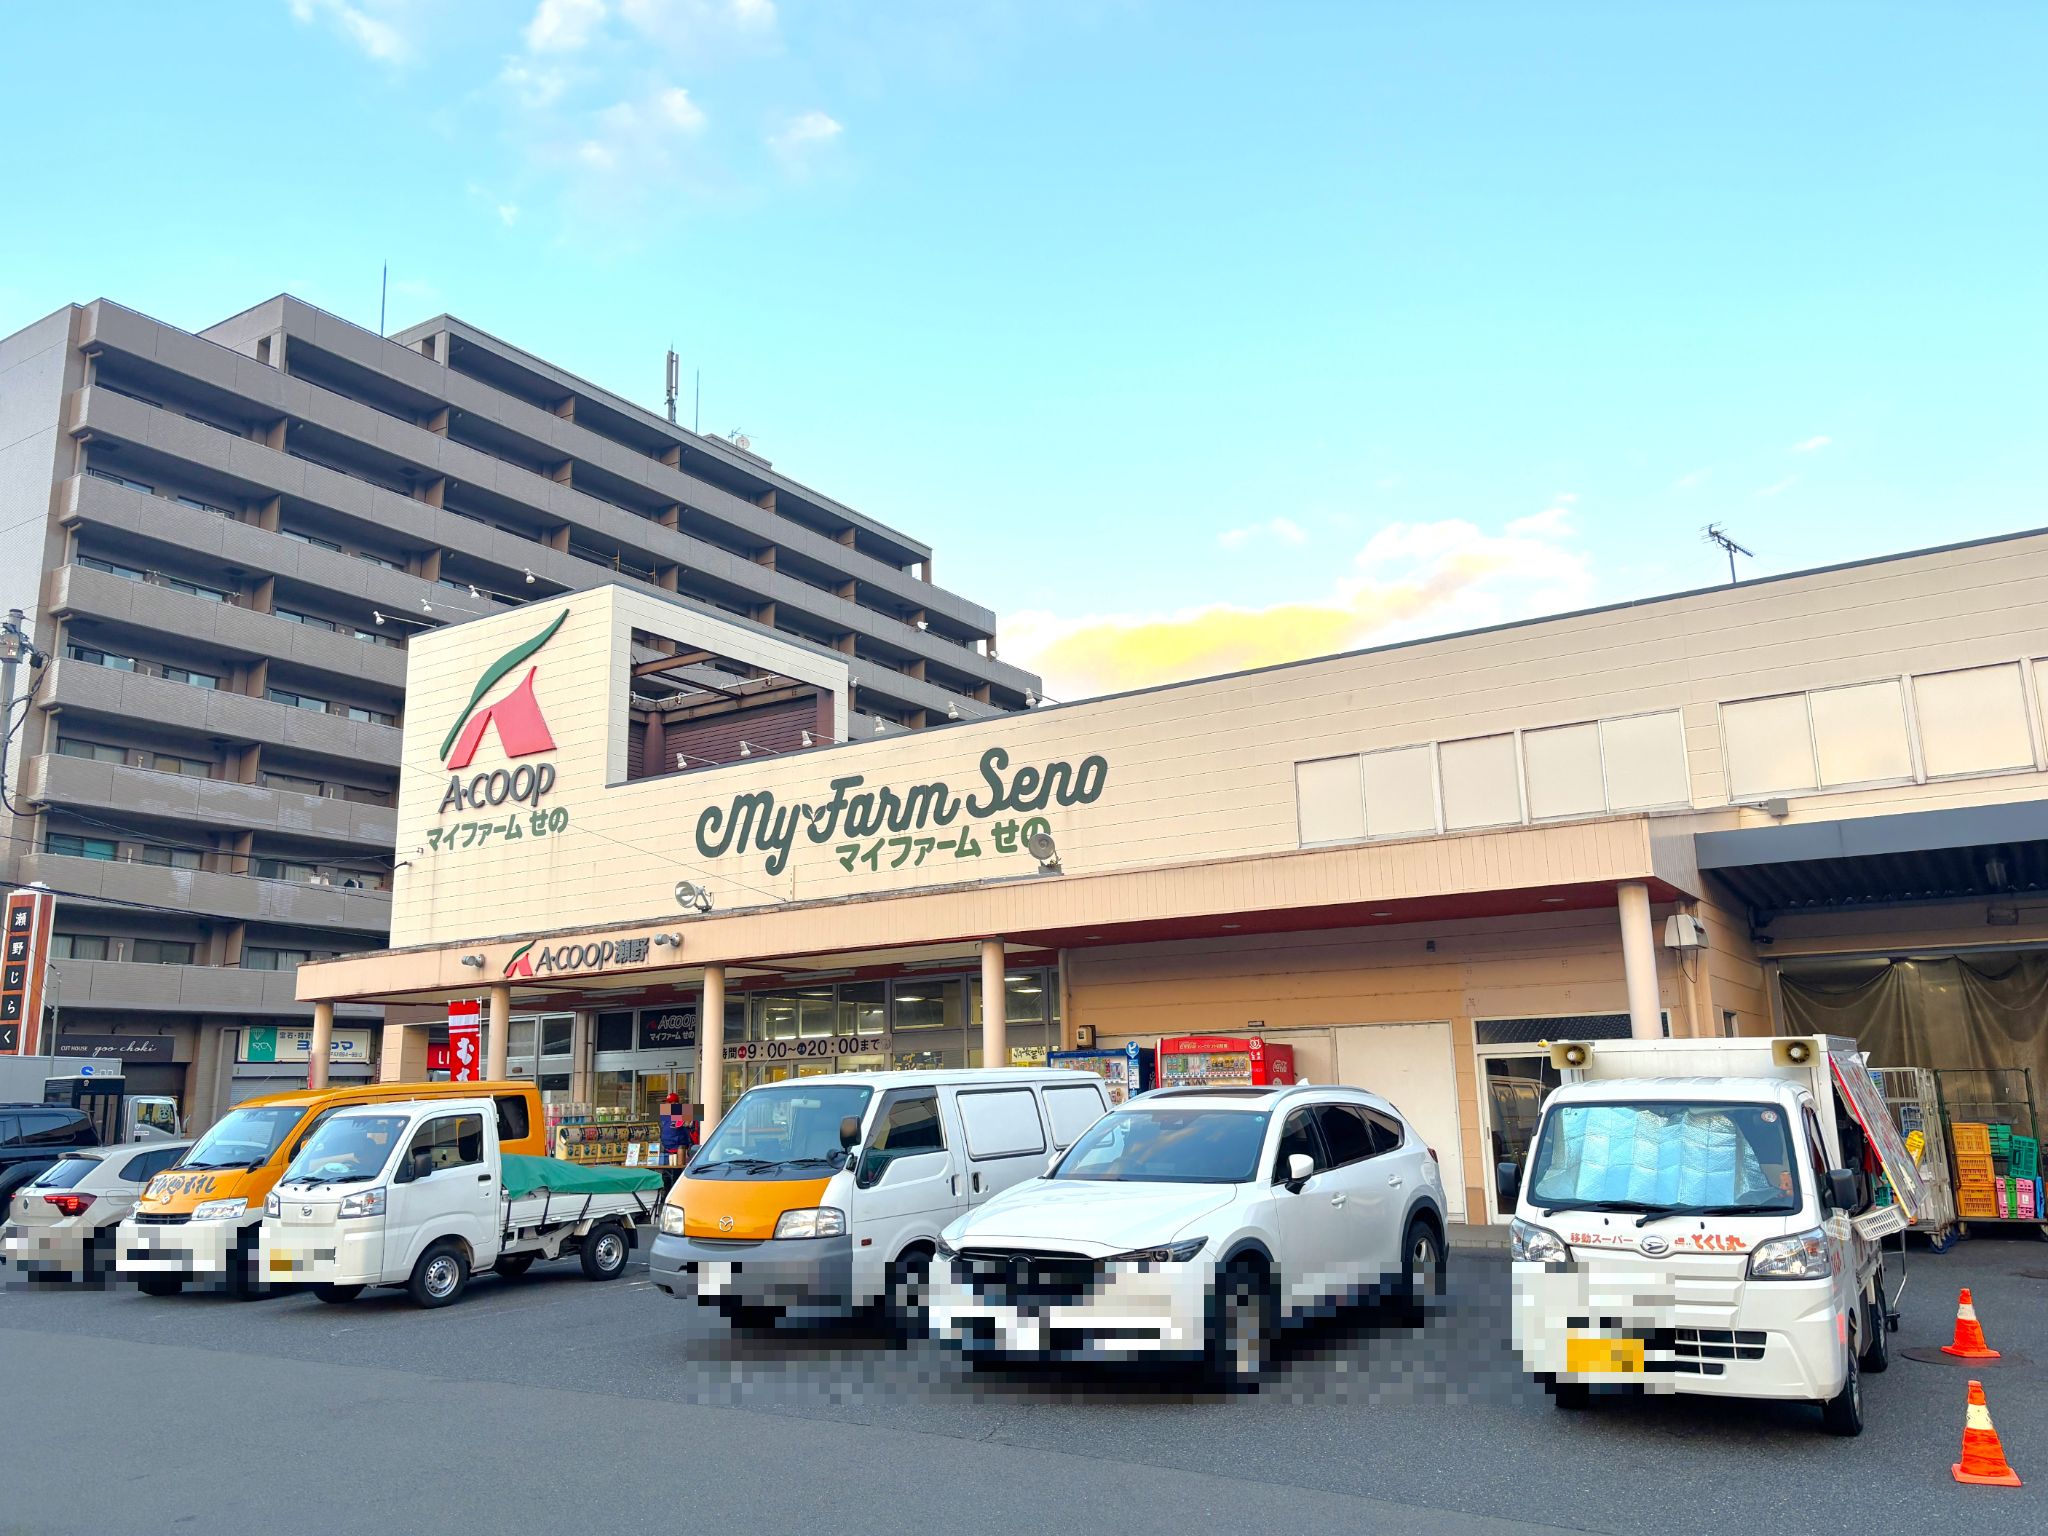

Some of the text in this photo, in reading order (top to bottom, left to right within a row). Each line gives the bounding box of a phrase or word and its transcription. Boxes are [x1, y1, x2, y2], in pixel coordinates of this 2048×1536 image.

[427, 807, 569, 851] マイファーム せの
[696, 747, 1108, 876] My Farm Seno
[836, 825, 982, 872] マイファーム
[4, 912, 27, 1044] 瀬野じらく
[120, 1040, 157, 1052] choki
[1570, 1232, 1747, 1251] 移動スーパー とくし丸
